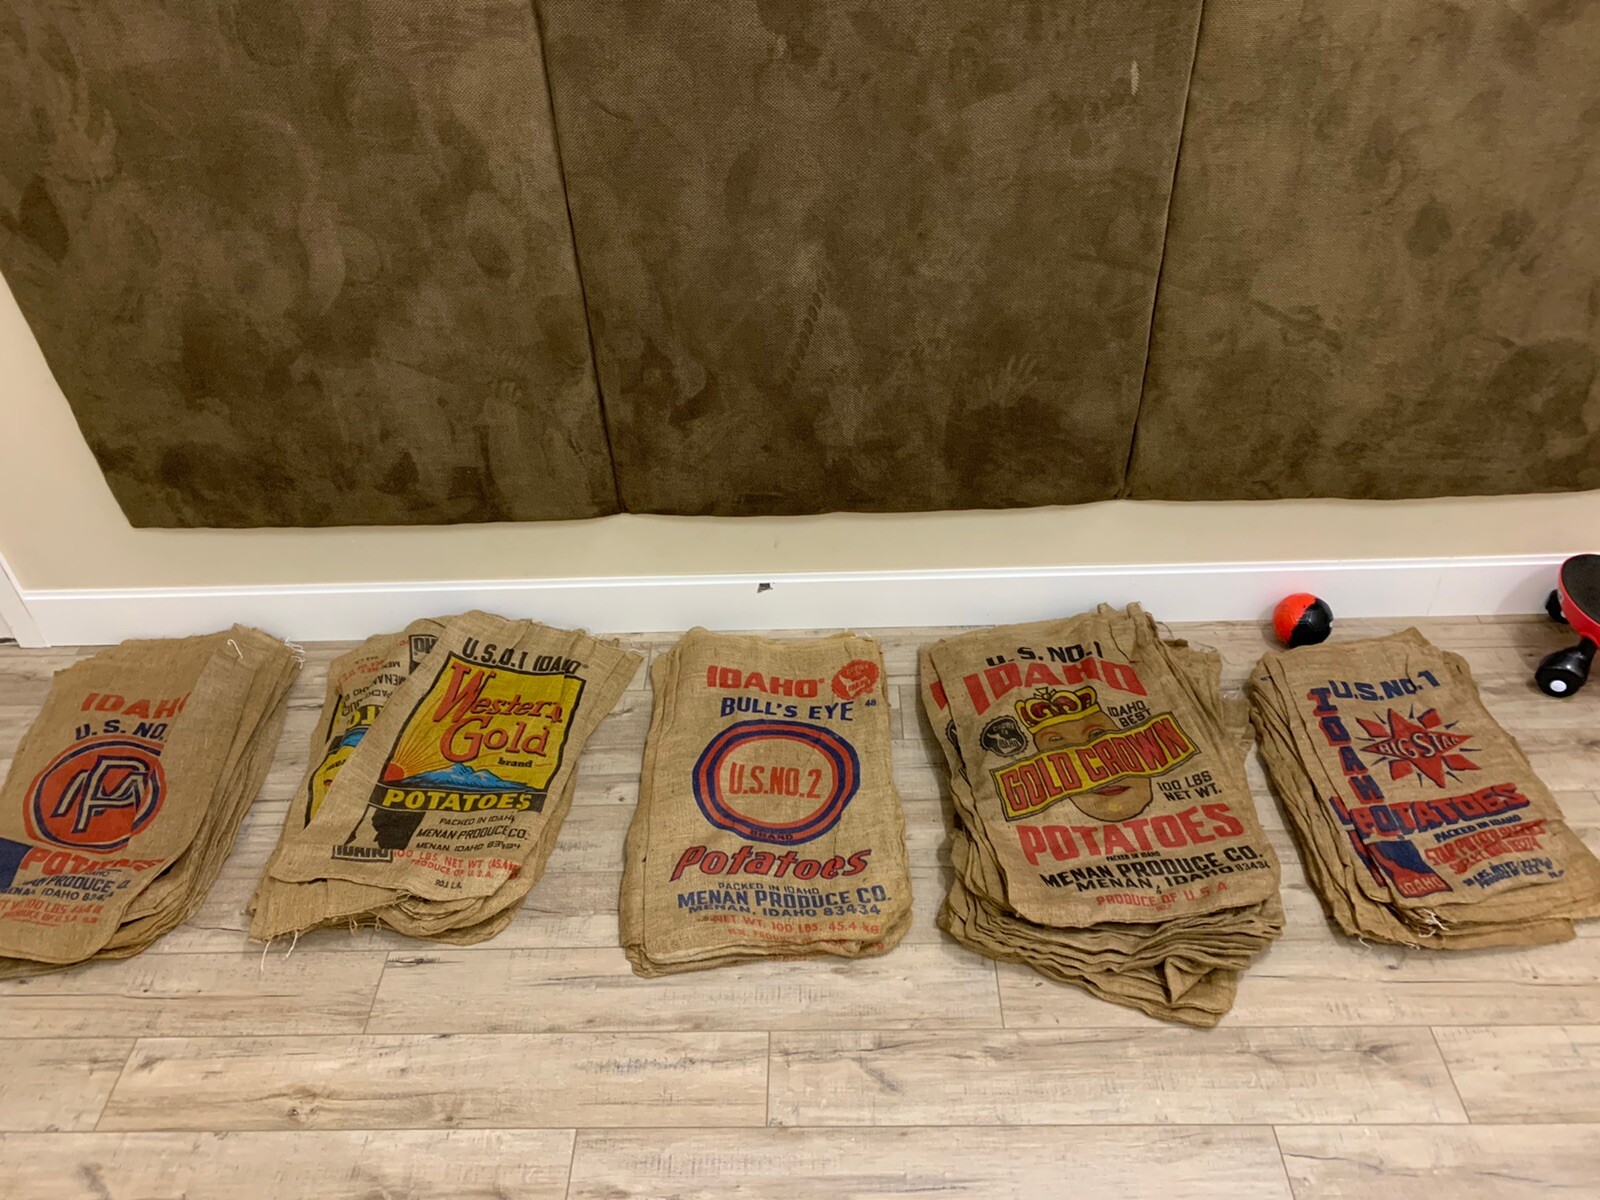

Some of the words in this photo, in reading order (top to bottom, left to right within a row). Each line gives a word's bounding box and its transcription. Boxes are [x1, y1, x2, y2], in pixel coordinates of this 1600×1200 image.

[706, 665, 819, 698] IDAHO
[963, 657, 1147, 716] IDAHO
[81, 693, 191, 719] IDAH
[720, 697, 798, 719] BULL'S
[808, 701, 854, 721] EYE
[1107, 700, 1147, 718] IDAHO
[1119, 709, 1153, 728] BEST
[440, 715, 550, 763] Gold
[1378, 737, 1420, 760] BIG
[498, 757, 533, 768] brand
[1000, 752, 1082, 812] GOLD
[1076, 717, 1190, 782] CROWN
[1156, 779, 1183, 792] 100
[1184, 770, 1213, 788] LBS
[382, 788, 530, 812] POTATOES
[1163, 789, 1192, 801] NET
[1194, 782, 1222, 799] WT.
[1349, 781, 1532, 840] POTATOES
[439, 817, 475, 826] PACKED
[477, 816, 486, 824] IN
[416, 828, 457, 841] MENAN
[457, 825, 509, 840] PRODUCE
[1017, 803, 1244, 865] POTATOES
[1433, 825, 1477, 843] PACKED
[455, 844, 485, 852] IDAHO
[445, 856, 464, 868] NET
[669, 845, 872, 882] Potatoes
[1039, 864, 1116, 888] MENAN
[1115, 852, 1222, 878] PRODUCE
[1227, 844, 1264, 862] CO.
[453, 869, 464, 877] OF
[1164, 867, 1235, 887] IDAHO
[41, 888, 80, 901] IDAHO
[718, 882, 764, 891] PACKED
[783, 886, 820, 896] IDAHO
[1400, 877, 1444, 895] IDAHO
[677, 890, 749, 908] MENAN
[754, 890, 850, 909] PRODUCE
[856, 884, 892, 904] CO.
[1096, 894, 1156, 908] PRODUCE
[1161, 891, 1177, 904] OF
[762, 908, 817, 917] IDAHO
[823, 903, 881, 916] 83434
[771, 921, 793, 933] 100
